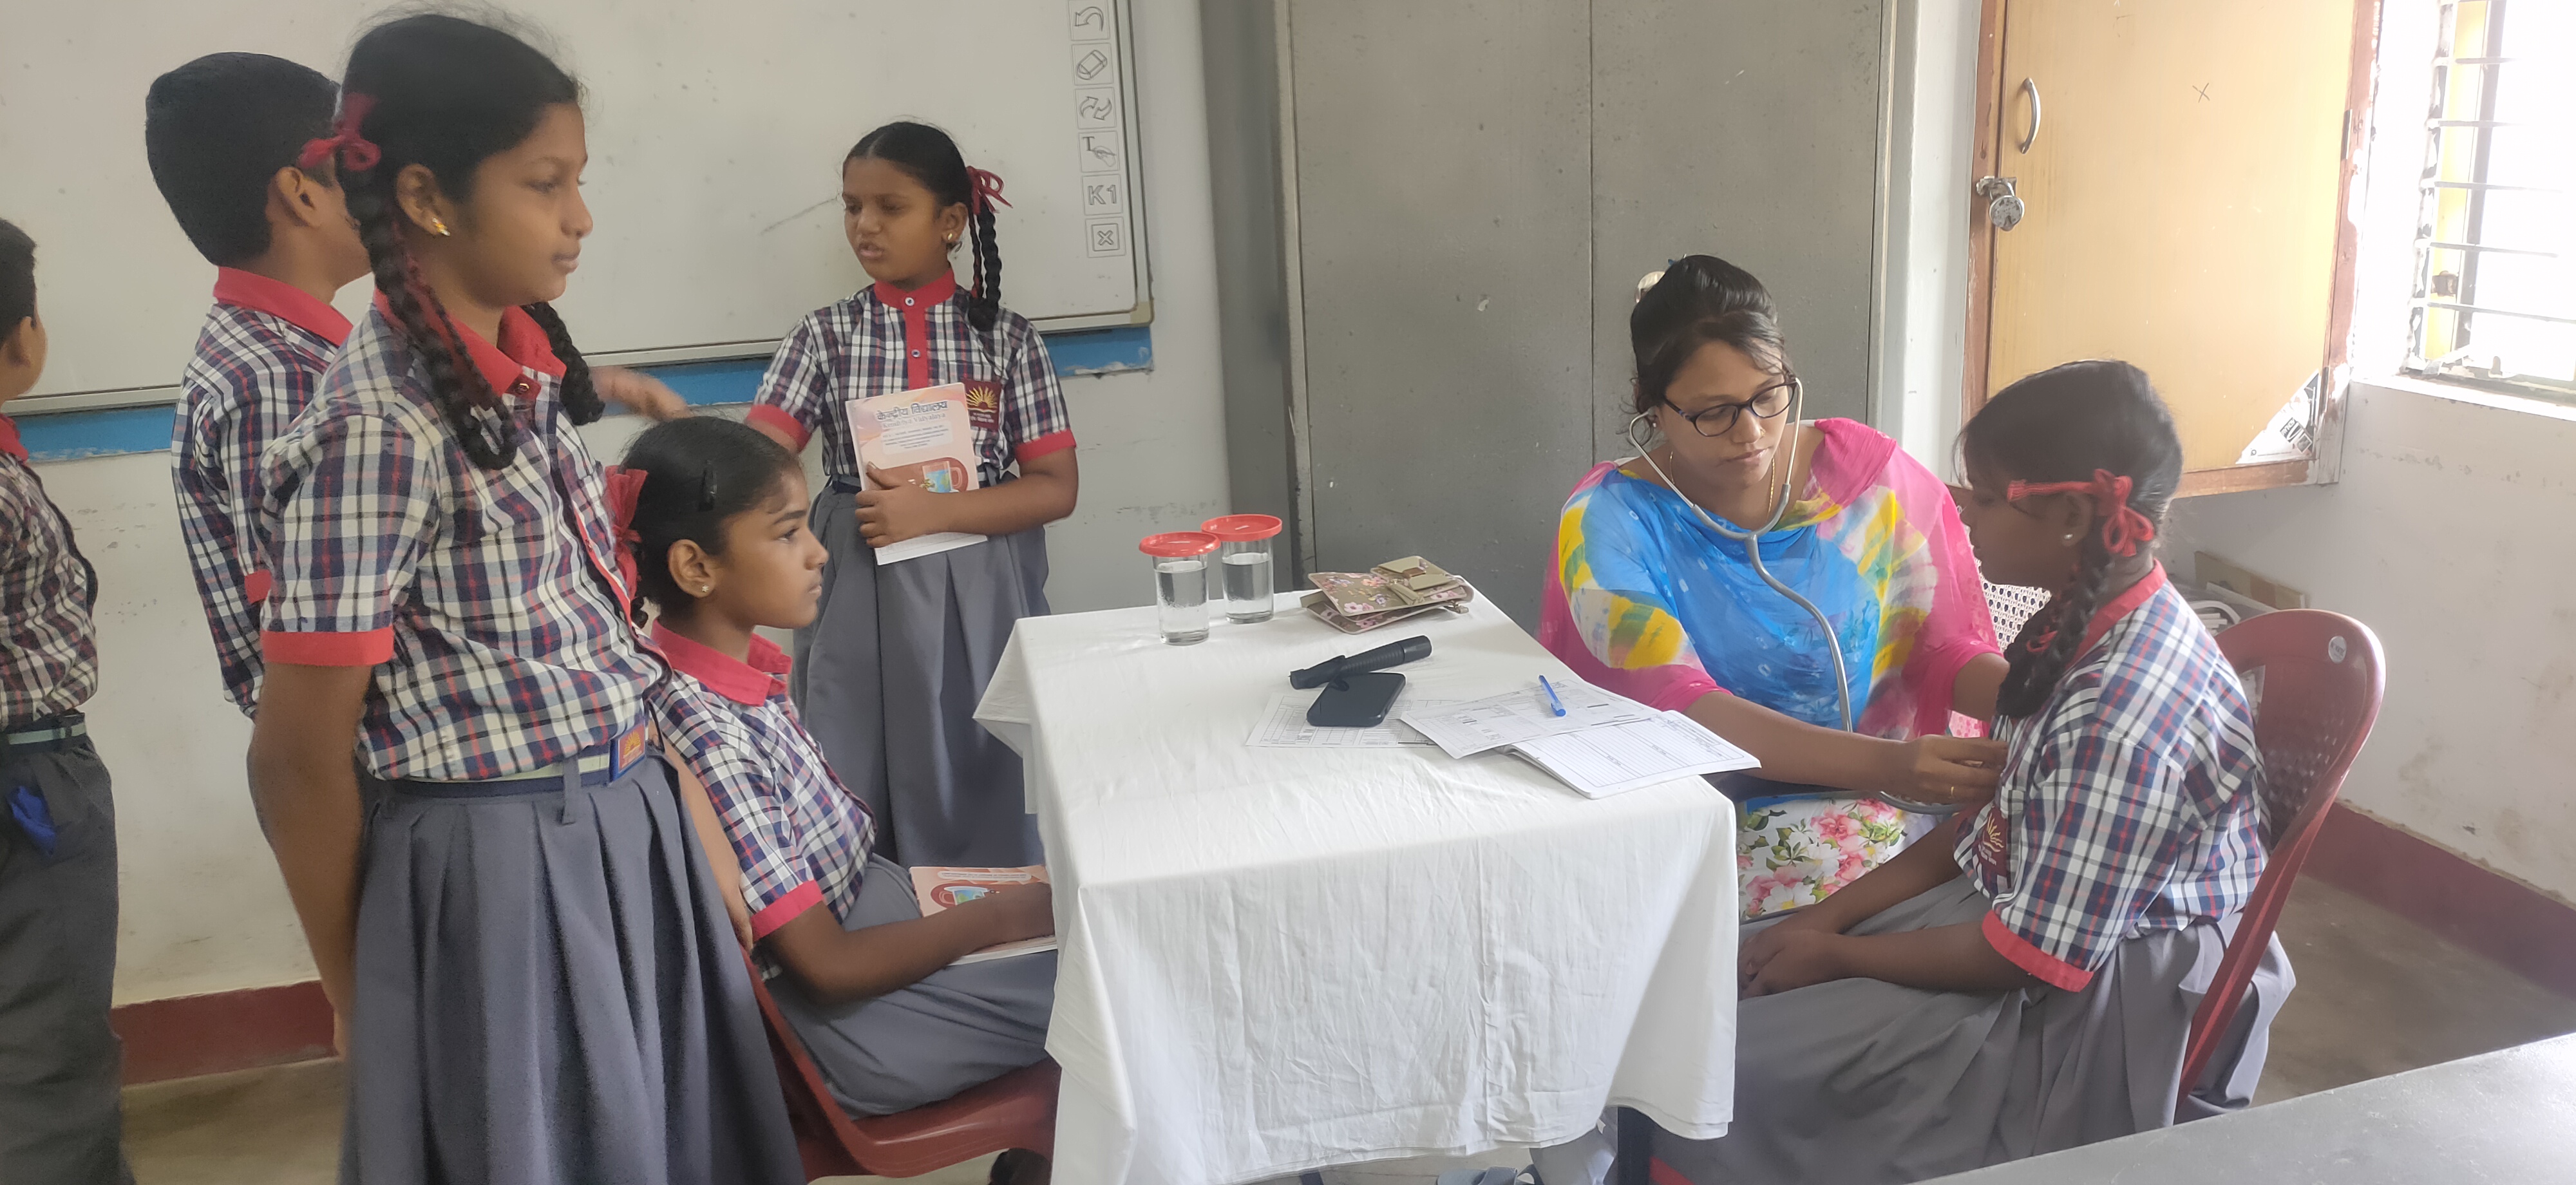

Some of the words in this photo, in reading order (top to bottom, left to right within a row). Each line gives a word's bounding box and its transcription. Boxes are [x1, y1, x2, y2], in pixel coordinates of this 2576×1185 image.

[1087, 184, 1117, 205] K1
[911, 401, 948, 414] विद्यालय
[914, 413, 946, 422] Vidyalaya
